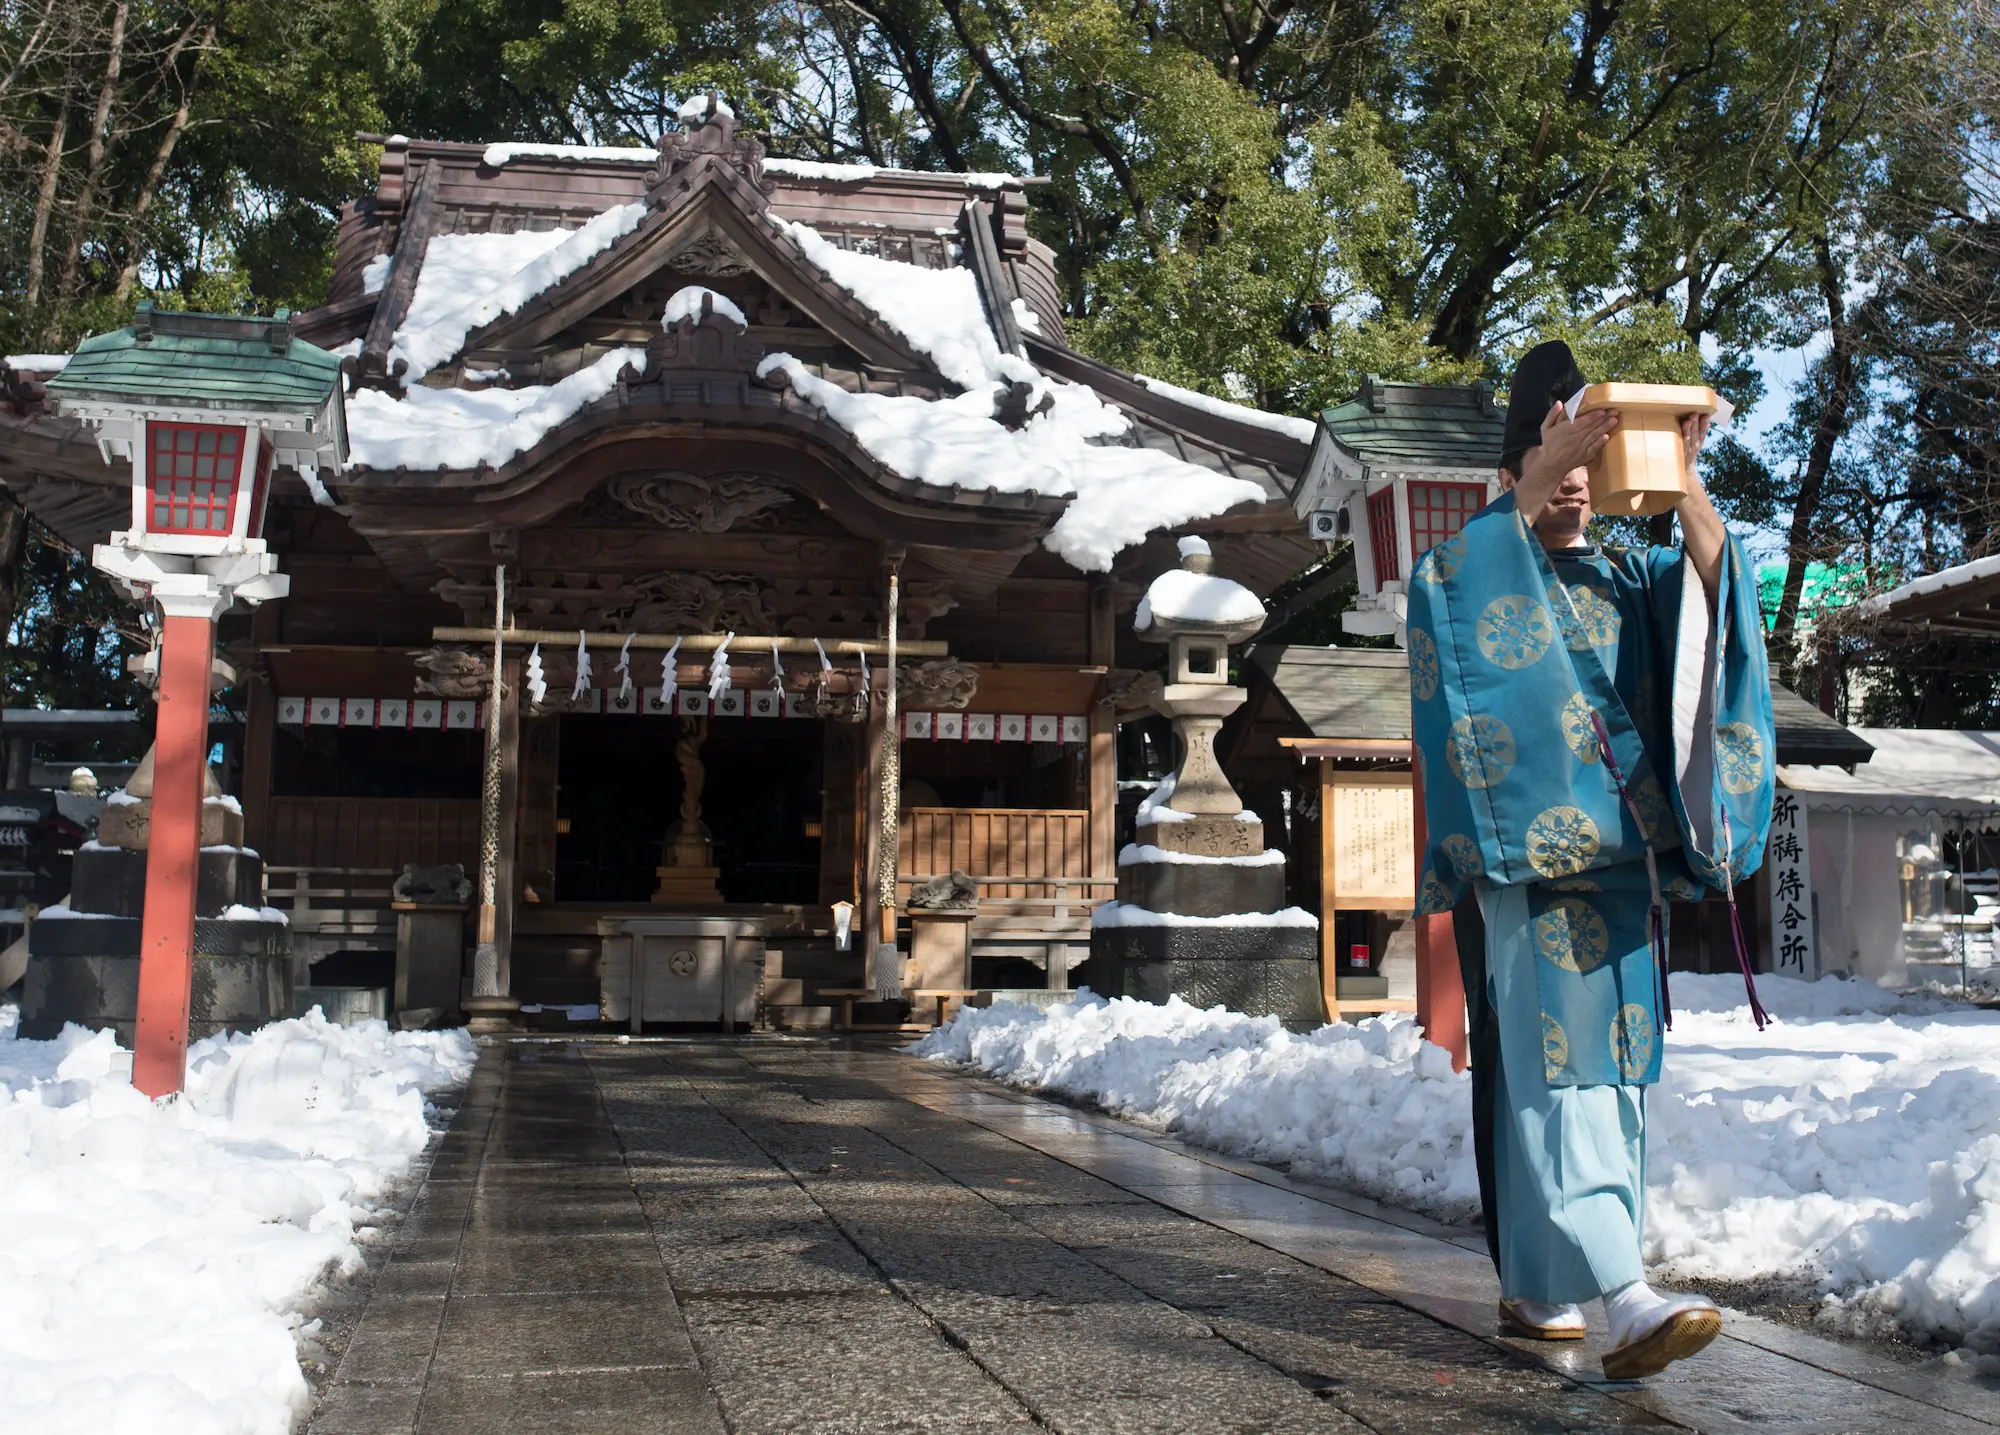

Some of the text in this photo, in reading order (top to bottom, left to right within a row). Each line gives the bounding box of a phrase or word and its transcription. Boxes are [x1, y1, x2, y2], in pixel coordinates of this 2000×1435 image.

[1771, 794, 1808, 974] 祈祷待合所
